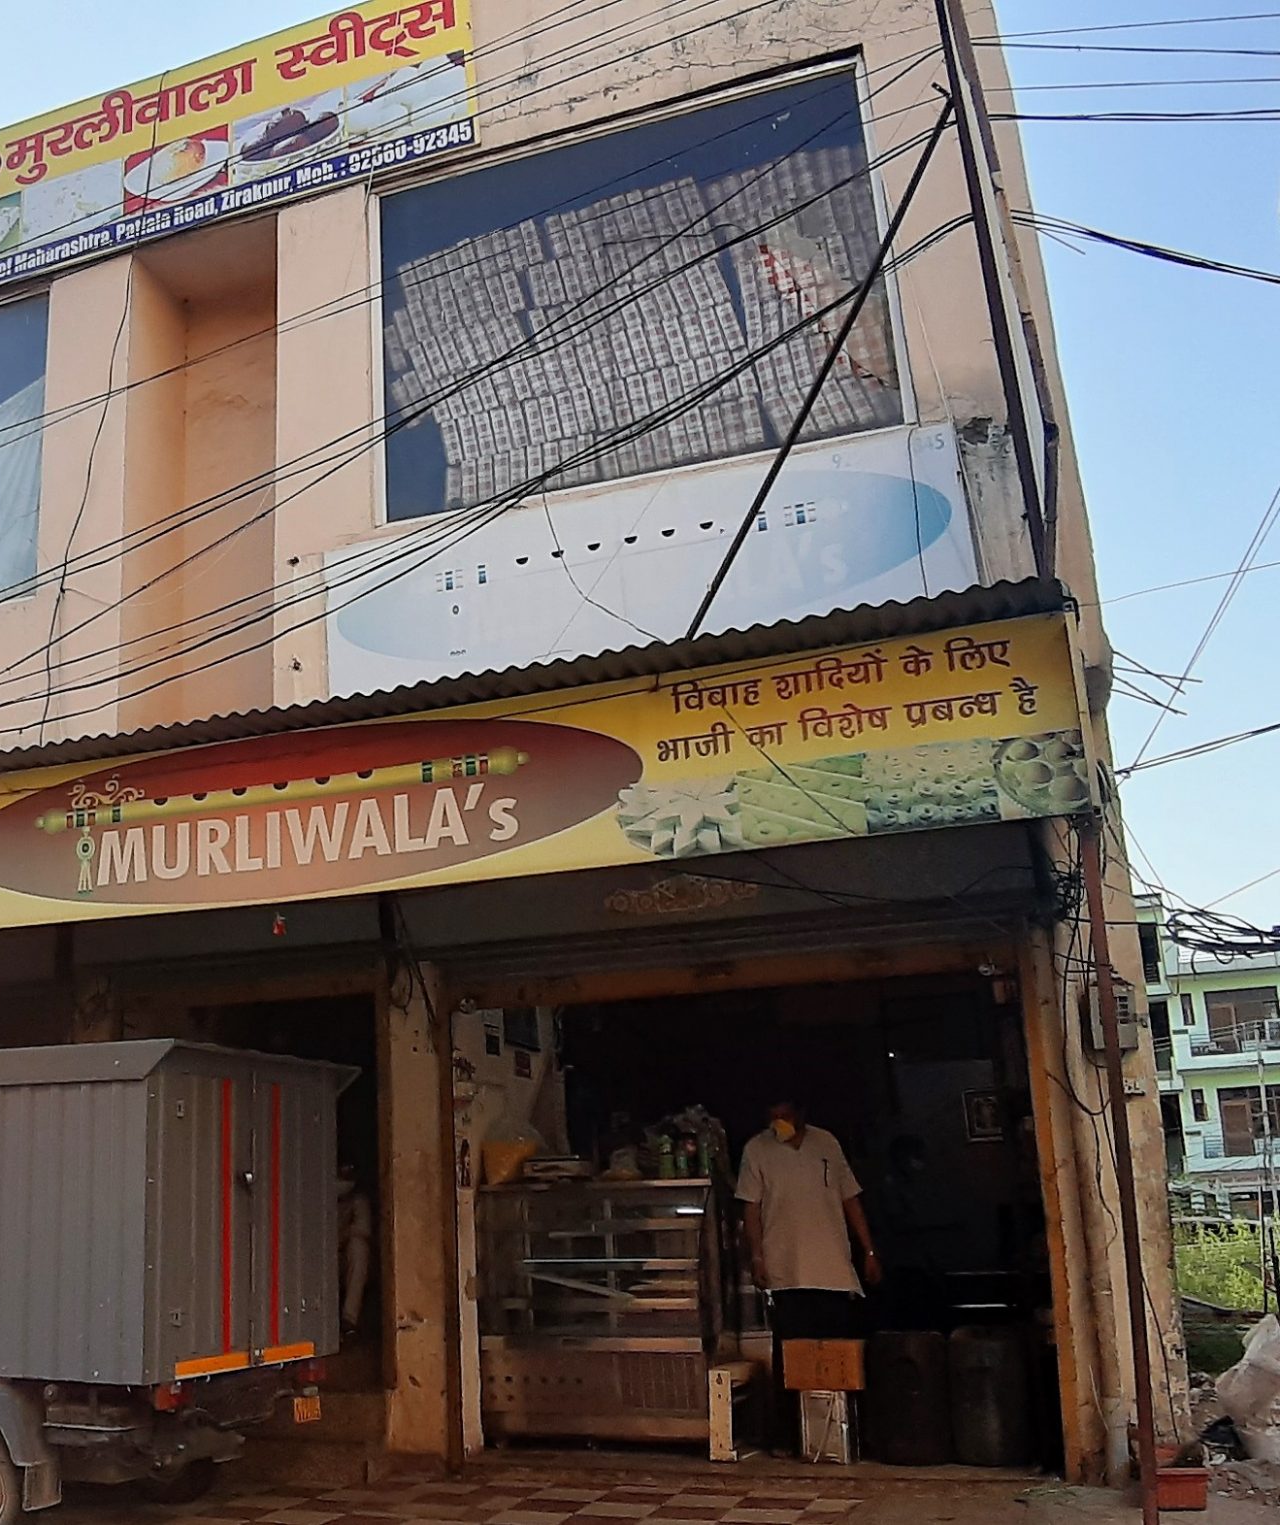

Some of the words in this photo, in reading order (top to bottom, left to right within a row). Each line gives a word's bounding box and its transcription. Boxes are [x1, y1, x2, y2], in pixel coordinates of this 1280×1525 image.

[5, 58, 257, 185] मुरलीवाला
[275, 0, 456, 81] स्वीट्स
[348, 121, 474, 173] 92560-92345
[771, 647, 888, 700] शादियों
[899, 645, 933, 677] के
[943, 636, 1011, 672] लिए
[657, 721, 735, 762] भाजी
[745, 722, 788, 749] का
[797, 702, 892, 741] विशेष
[903, 690, 1003, 729] प्रबन्ध
[1009, 676, 1039, 715] है
[96, 782, 520, 887] MURLIWALA's
